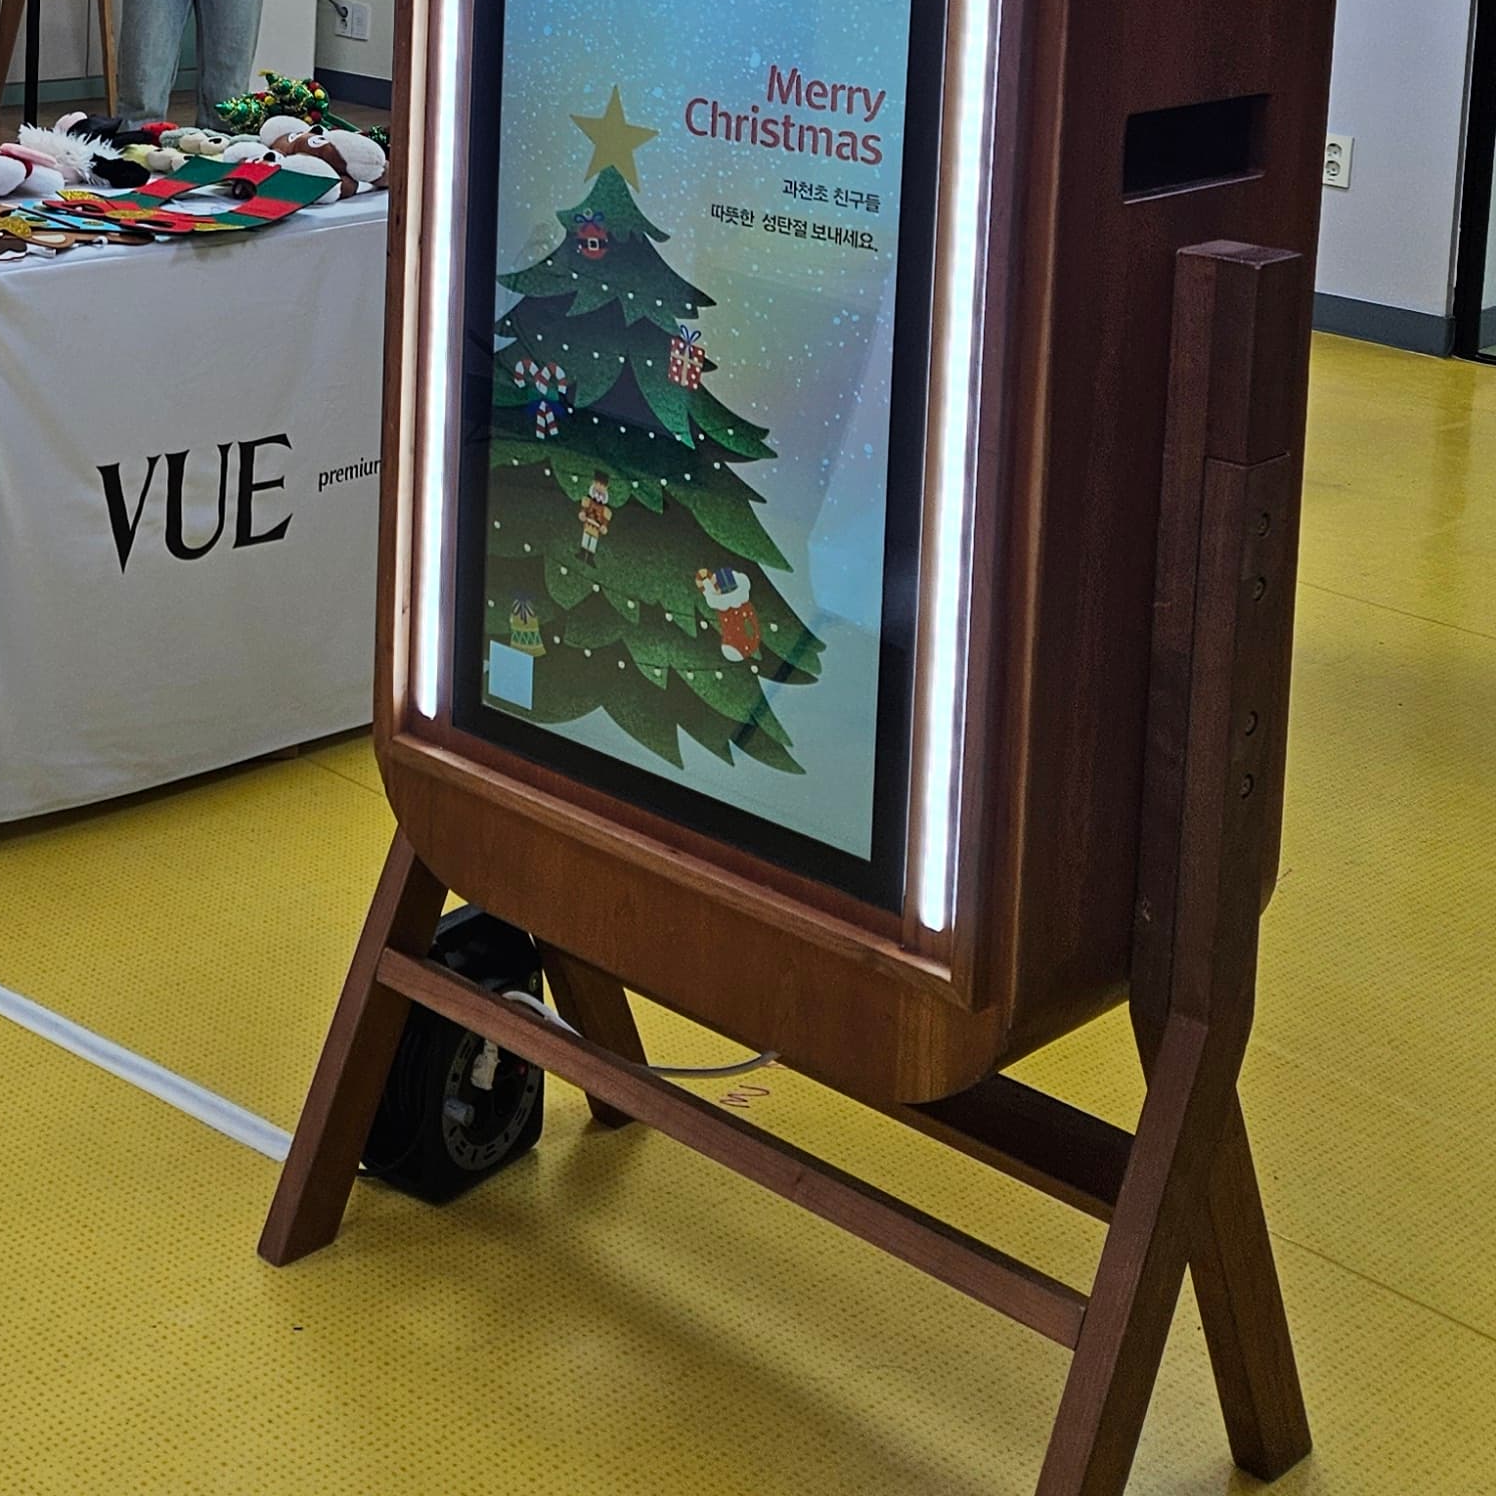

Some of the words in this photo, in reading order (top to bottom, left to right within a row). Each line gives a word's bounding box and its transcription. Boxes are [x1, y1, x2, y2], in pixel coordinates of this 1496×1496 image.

[766, 64, 887, 123] Merry
[684, 97, 884, 166] Christmas
[782, 179, 830, 204] 과천초
[832, 187, 881, 214] 친구들
[711, 204, 756, 228] 따뜻한
[762, 213, 808, 239] 성탄절
[811, 222, 879, 252] 보내세요.
[96, 432, 293, 575] VUE
